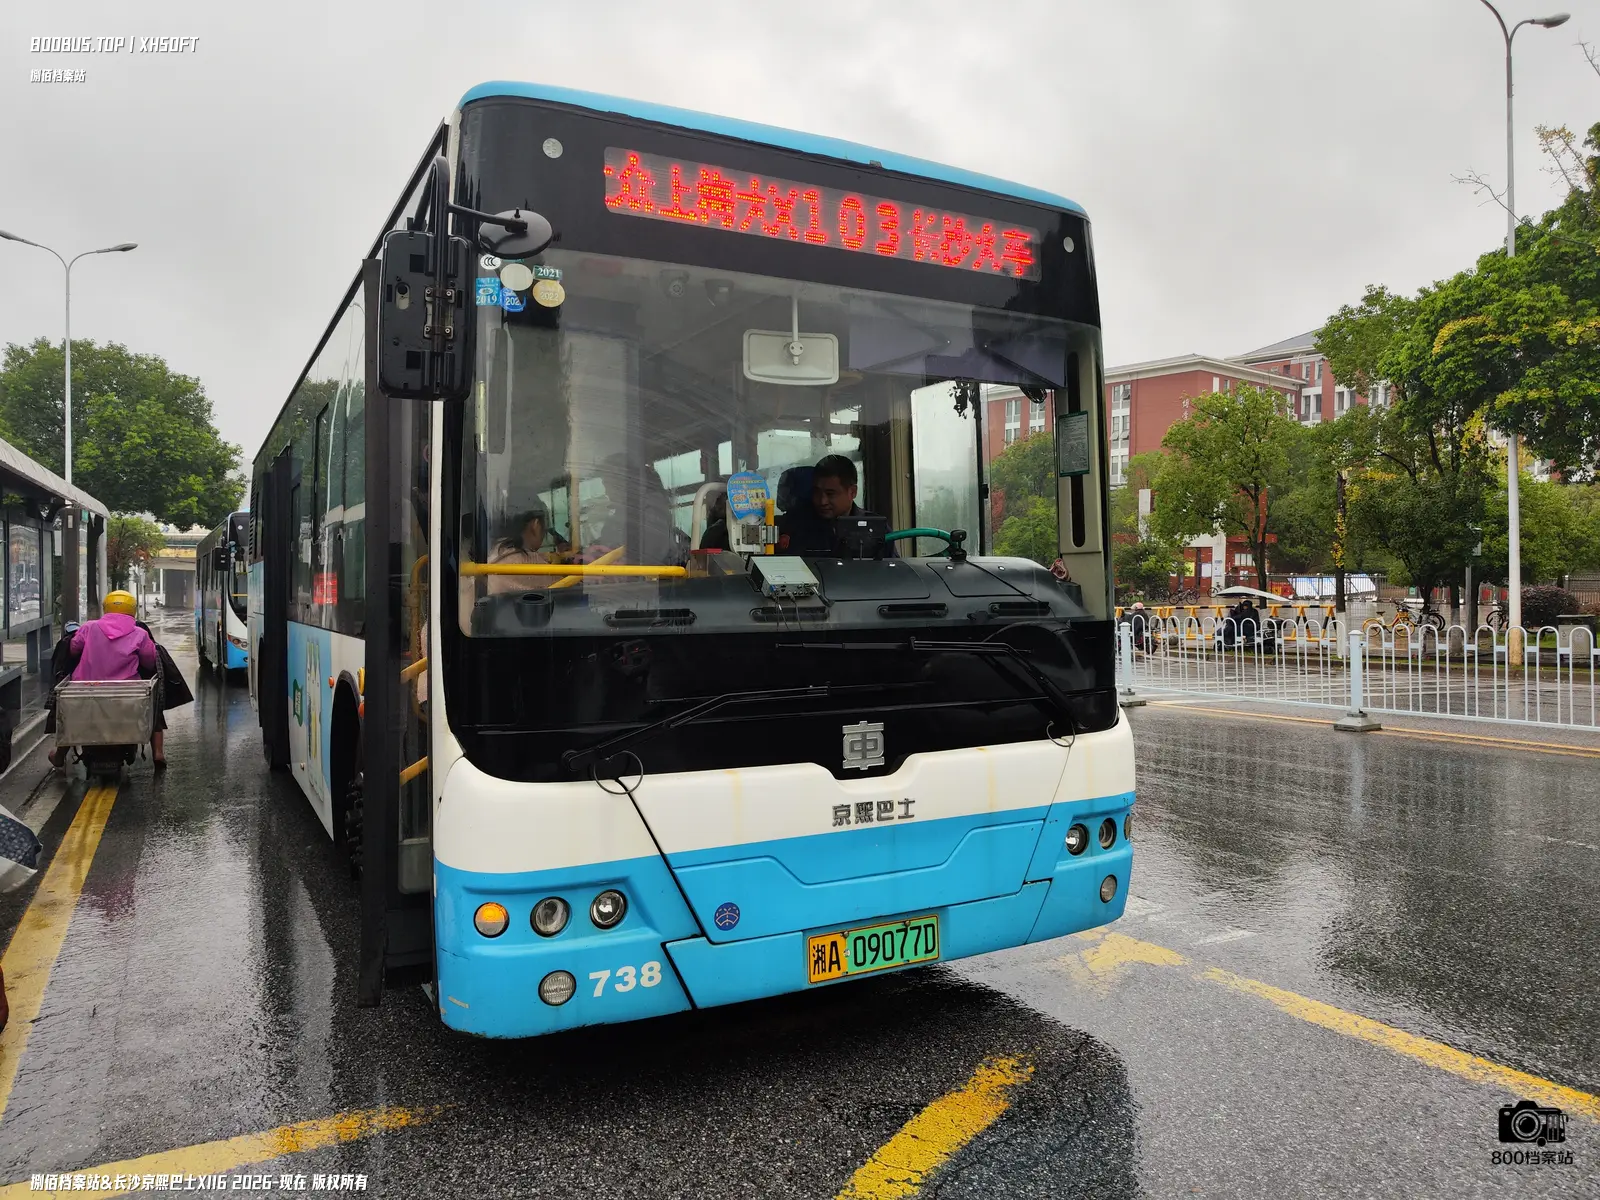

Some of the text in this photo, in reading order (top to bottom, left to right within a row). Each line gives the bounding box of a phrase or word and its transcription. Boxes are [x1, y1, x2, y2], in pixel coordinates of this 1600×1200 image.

[537, 266, 561, 278] 2021
[476, 294, 498, 305] 2019
[832, 797, 916, 827] 京熙巴士
[588, 960, 663, 998] 738
